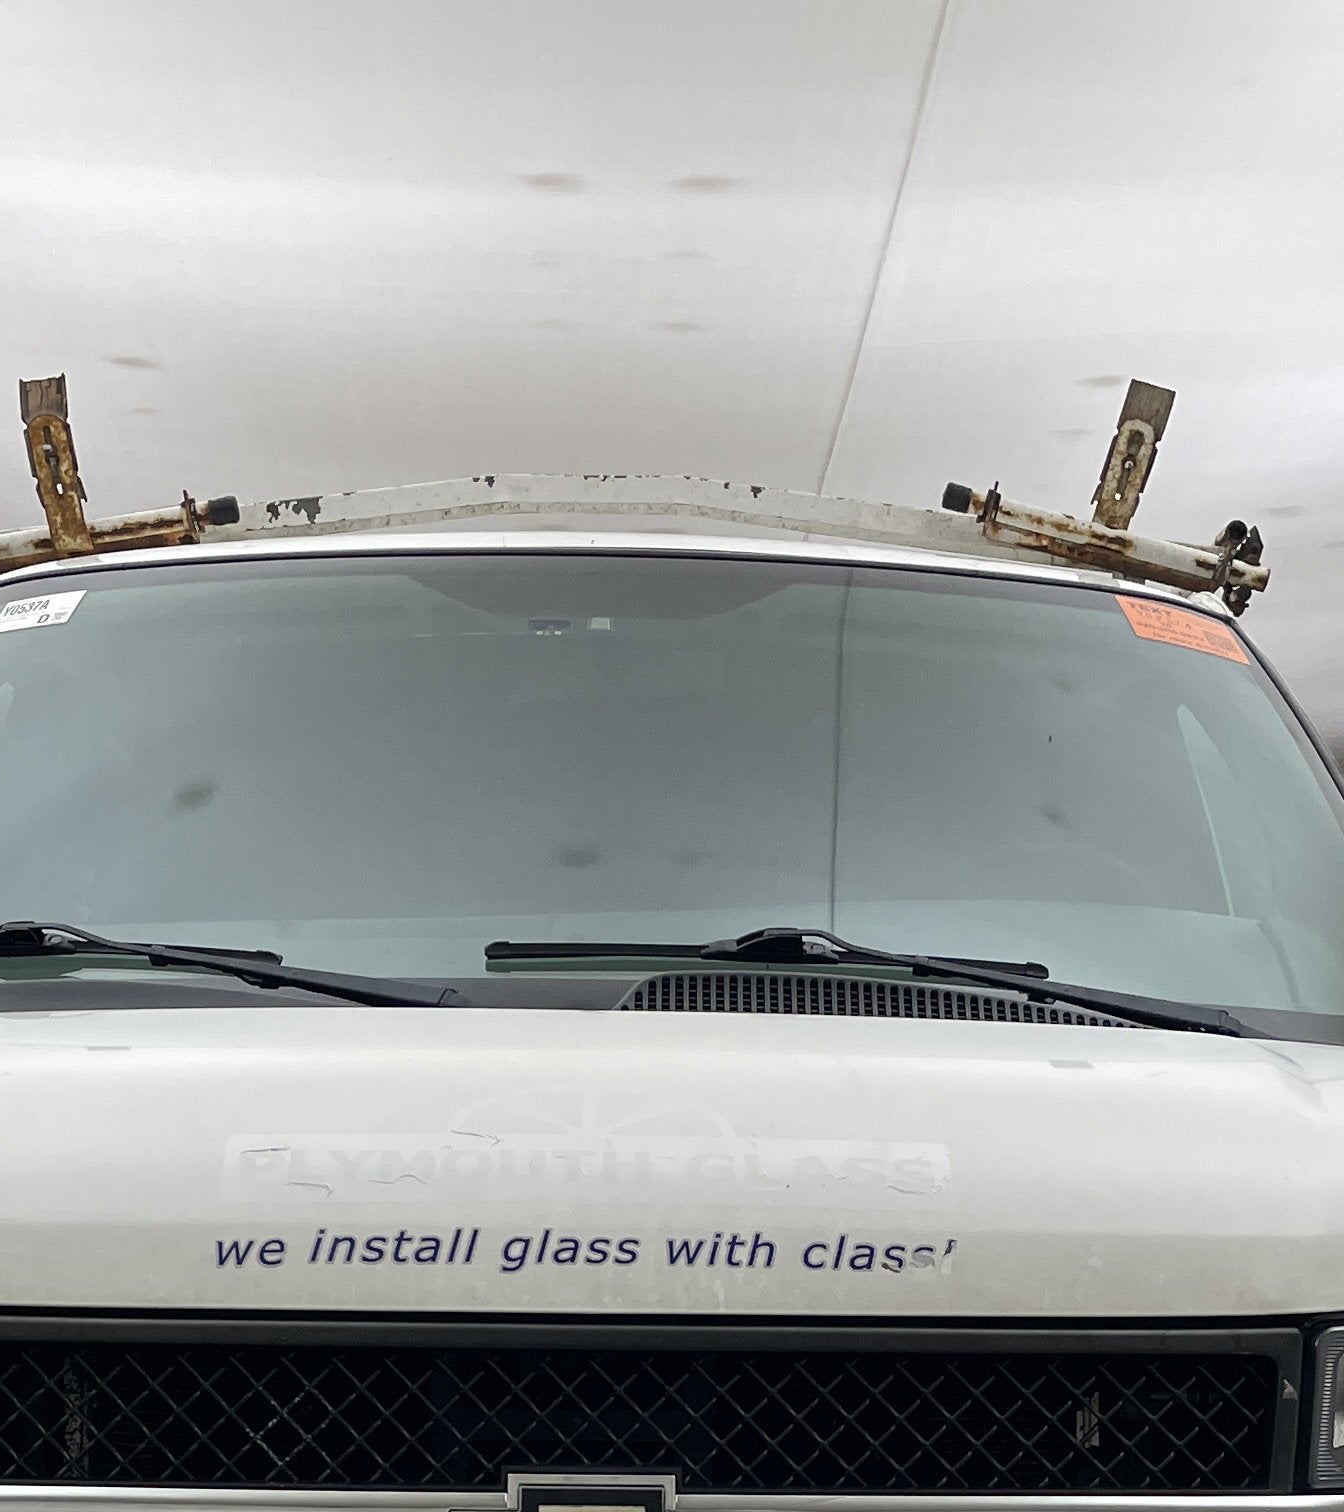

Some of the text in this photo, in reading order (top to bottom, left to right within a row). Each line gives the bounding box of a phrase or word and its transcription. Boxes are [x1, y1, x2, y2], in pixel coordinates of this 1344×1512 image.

[236, 1147, 944, 1191] PLYMOUTH GLASS
[215, 1238, 286, 1268] we
[308, 1227, 482, 1265] install
[499, 1227, 642, 1274] glass
[665, 1230, 775, 1271] with
